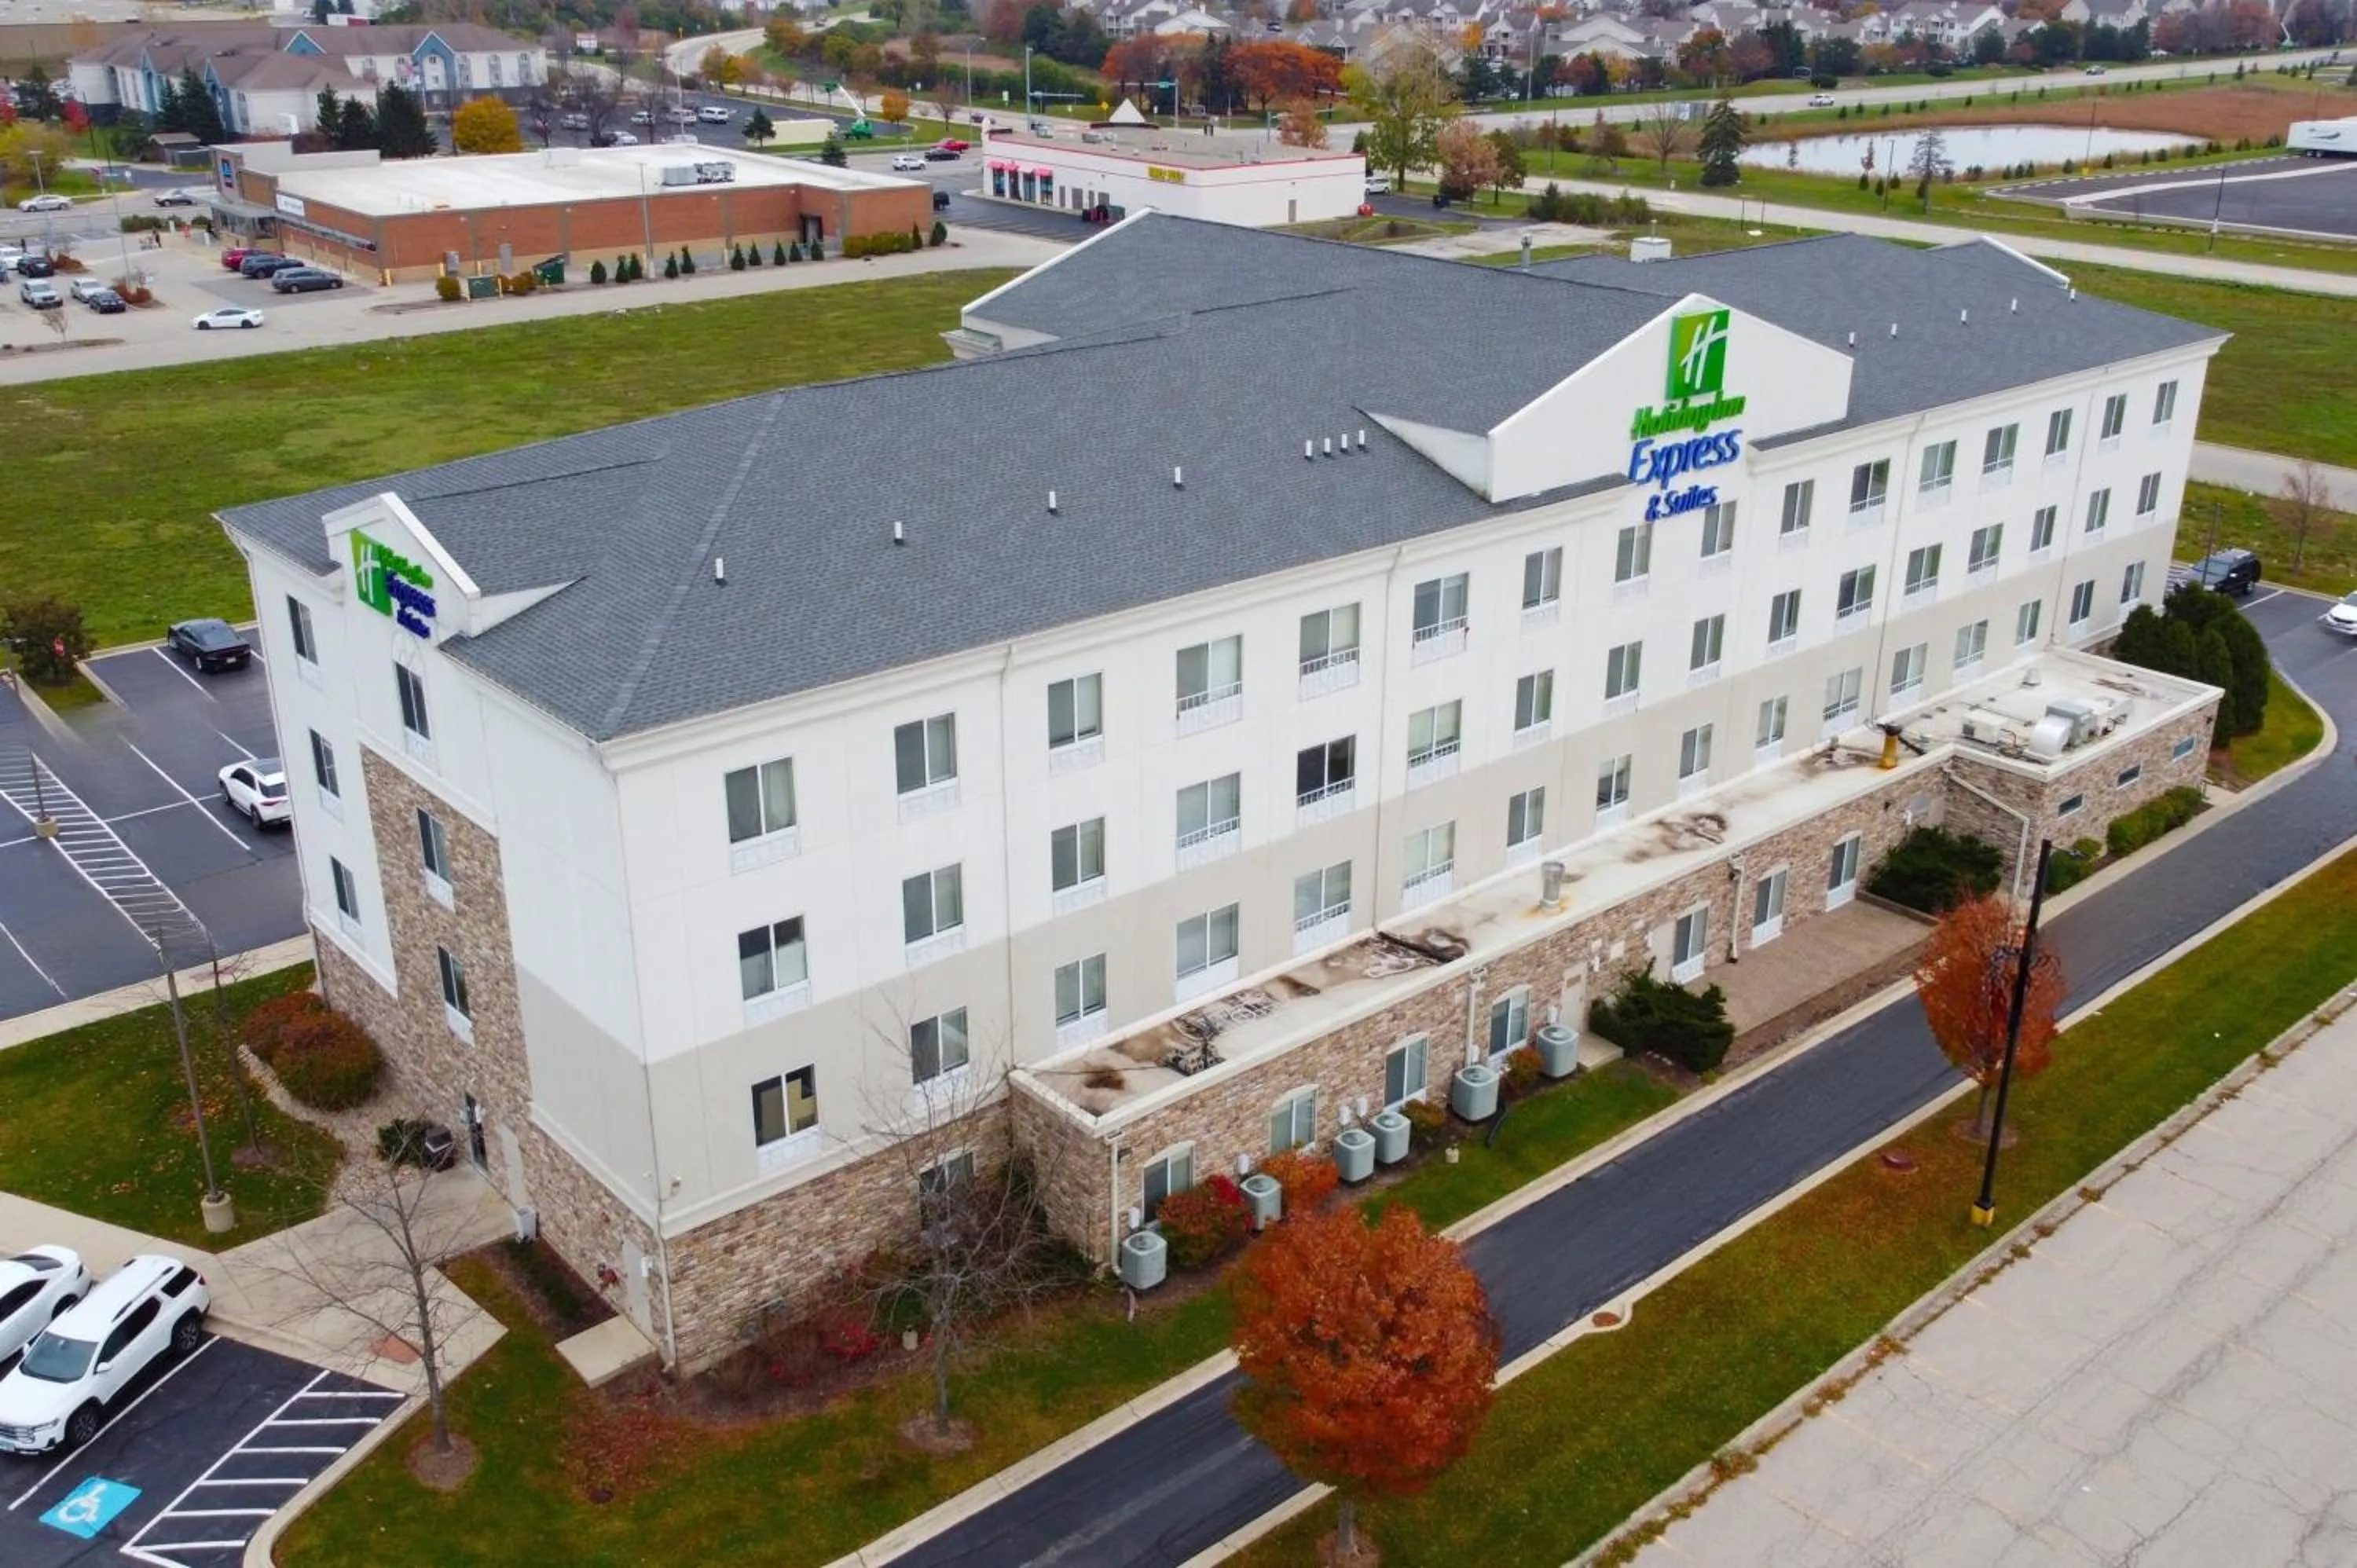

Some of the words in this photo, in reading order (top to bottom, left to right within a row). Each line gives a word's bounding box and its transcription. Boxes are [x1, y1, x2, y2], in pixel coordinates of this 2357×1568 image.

[1630, 397, 1712, 440] Holiday
[1629, 429, 1743, 489] Express
[1645, 493, 1660, 522] &
[1660, 485, 1719, 518] Suites
